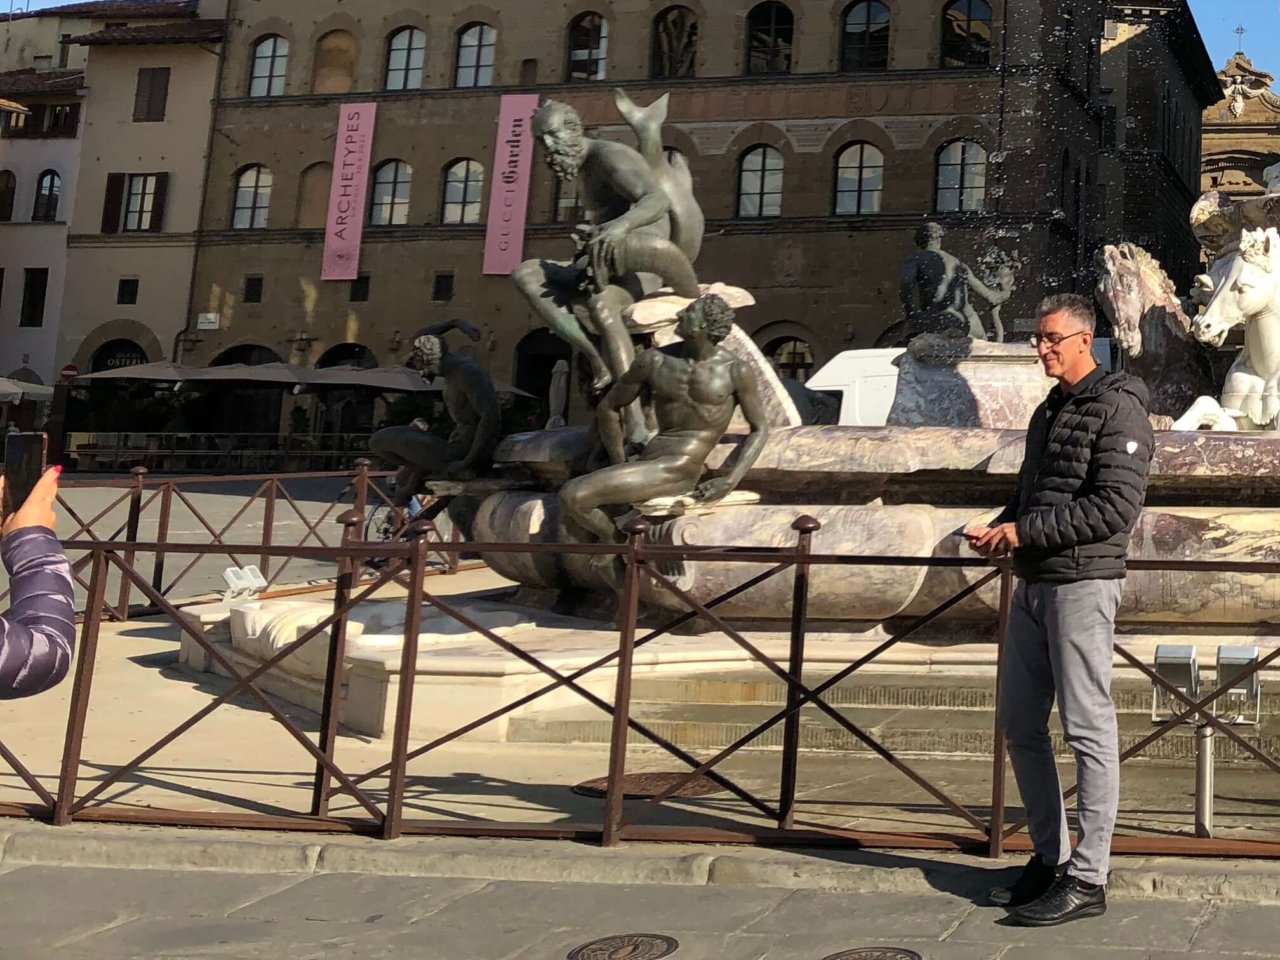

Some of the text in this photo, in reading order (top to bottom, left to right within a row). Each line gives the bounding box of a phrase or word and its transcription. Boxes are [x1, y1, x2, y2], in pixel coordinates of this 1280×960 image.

[334, 111, 361, 240] ARCHETYPES
[499, 118, 525, 251] GUCCI Garden
